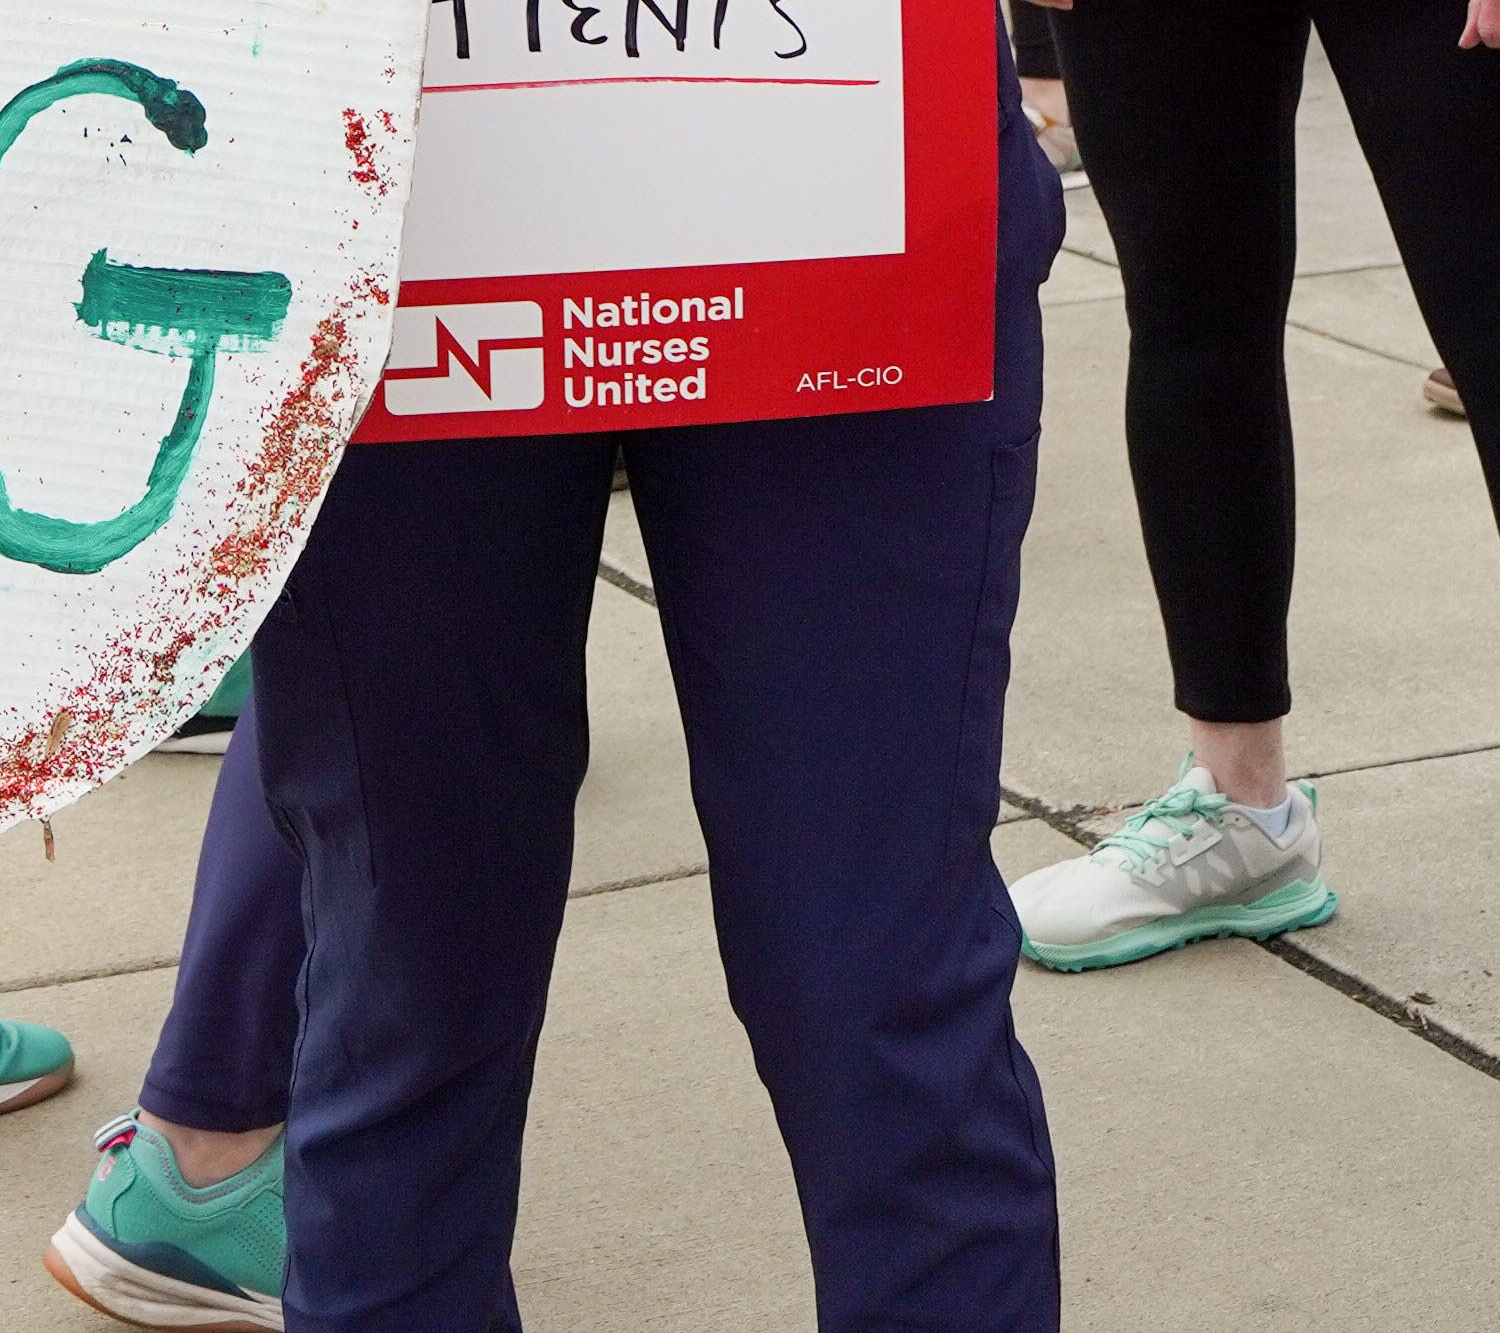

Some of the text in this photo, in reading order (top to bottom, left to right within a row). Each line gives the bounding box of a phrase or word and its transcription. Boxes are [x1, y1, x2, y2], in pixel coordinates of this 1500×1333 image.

[564, 288, 742, 328] National
[565, 337, 709, 368] Nurses
[565, 368, 705, 407] United
[797, 366, 902, 391] AFL-CIO
